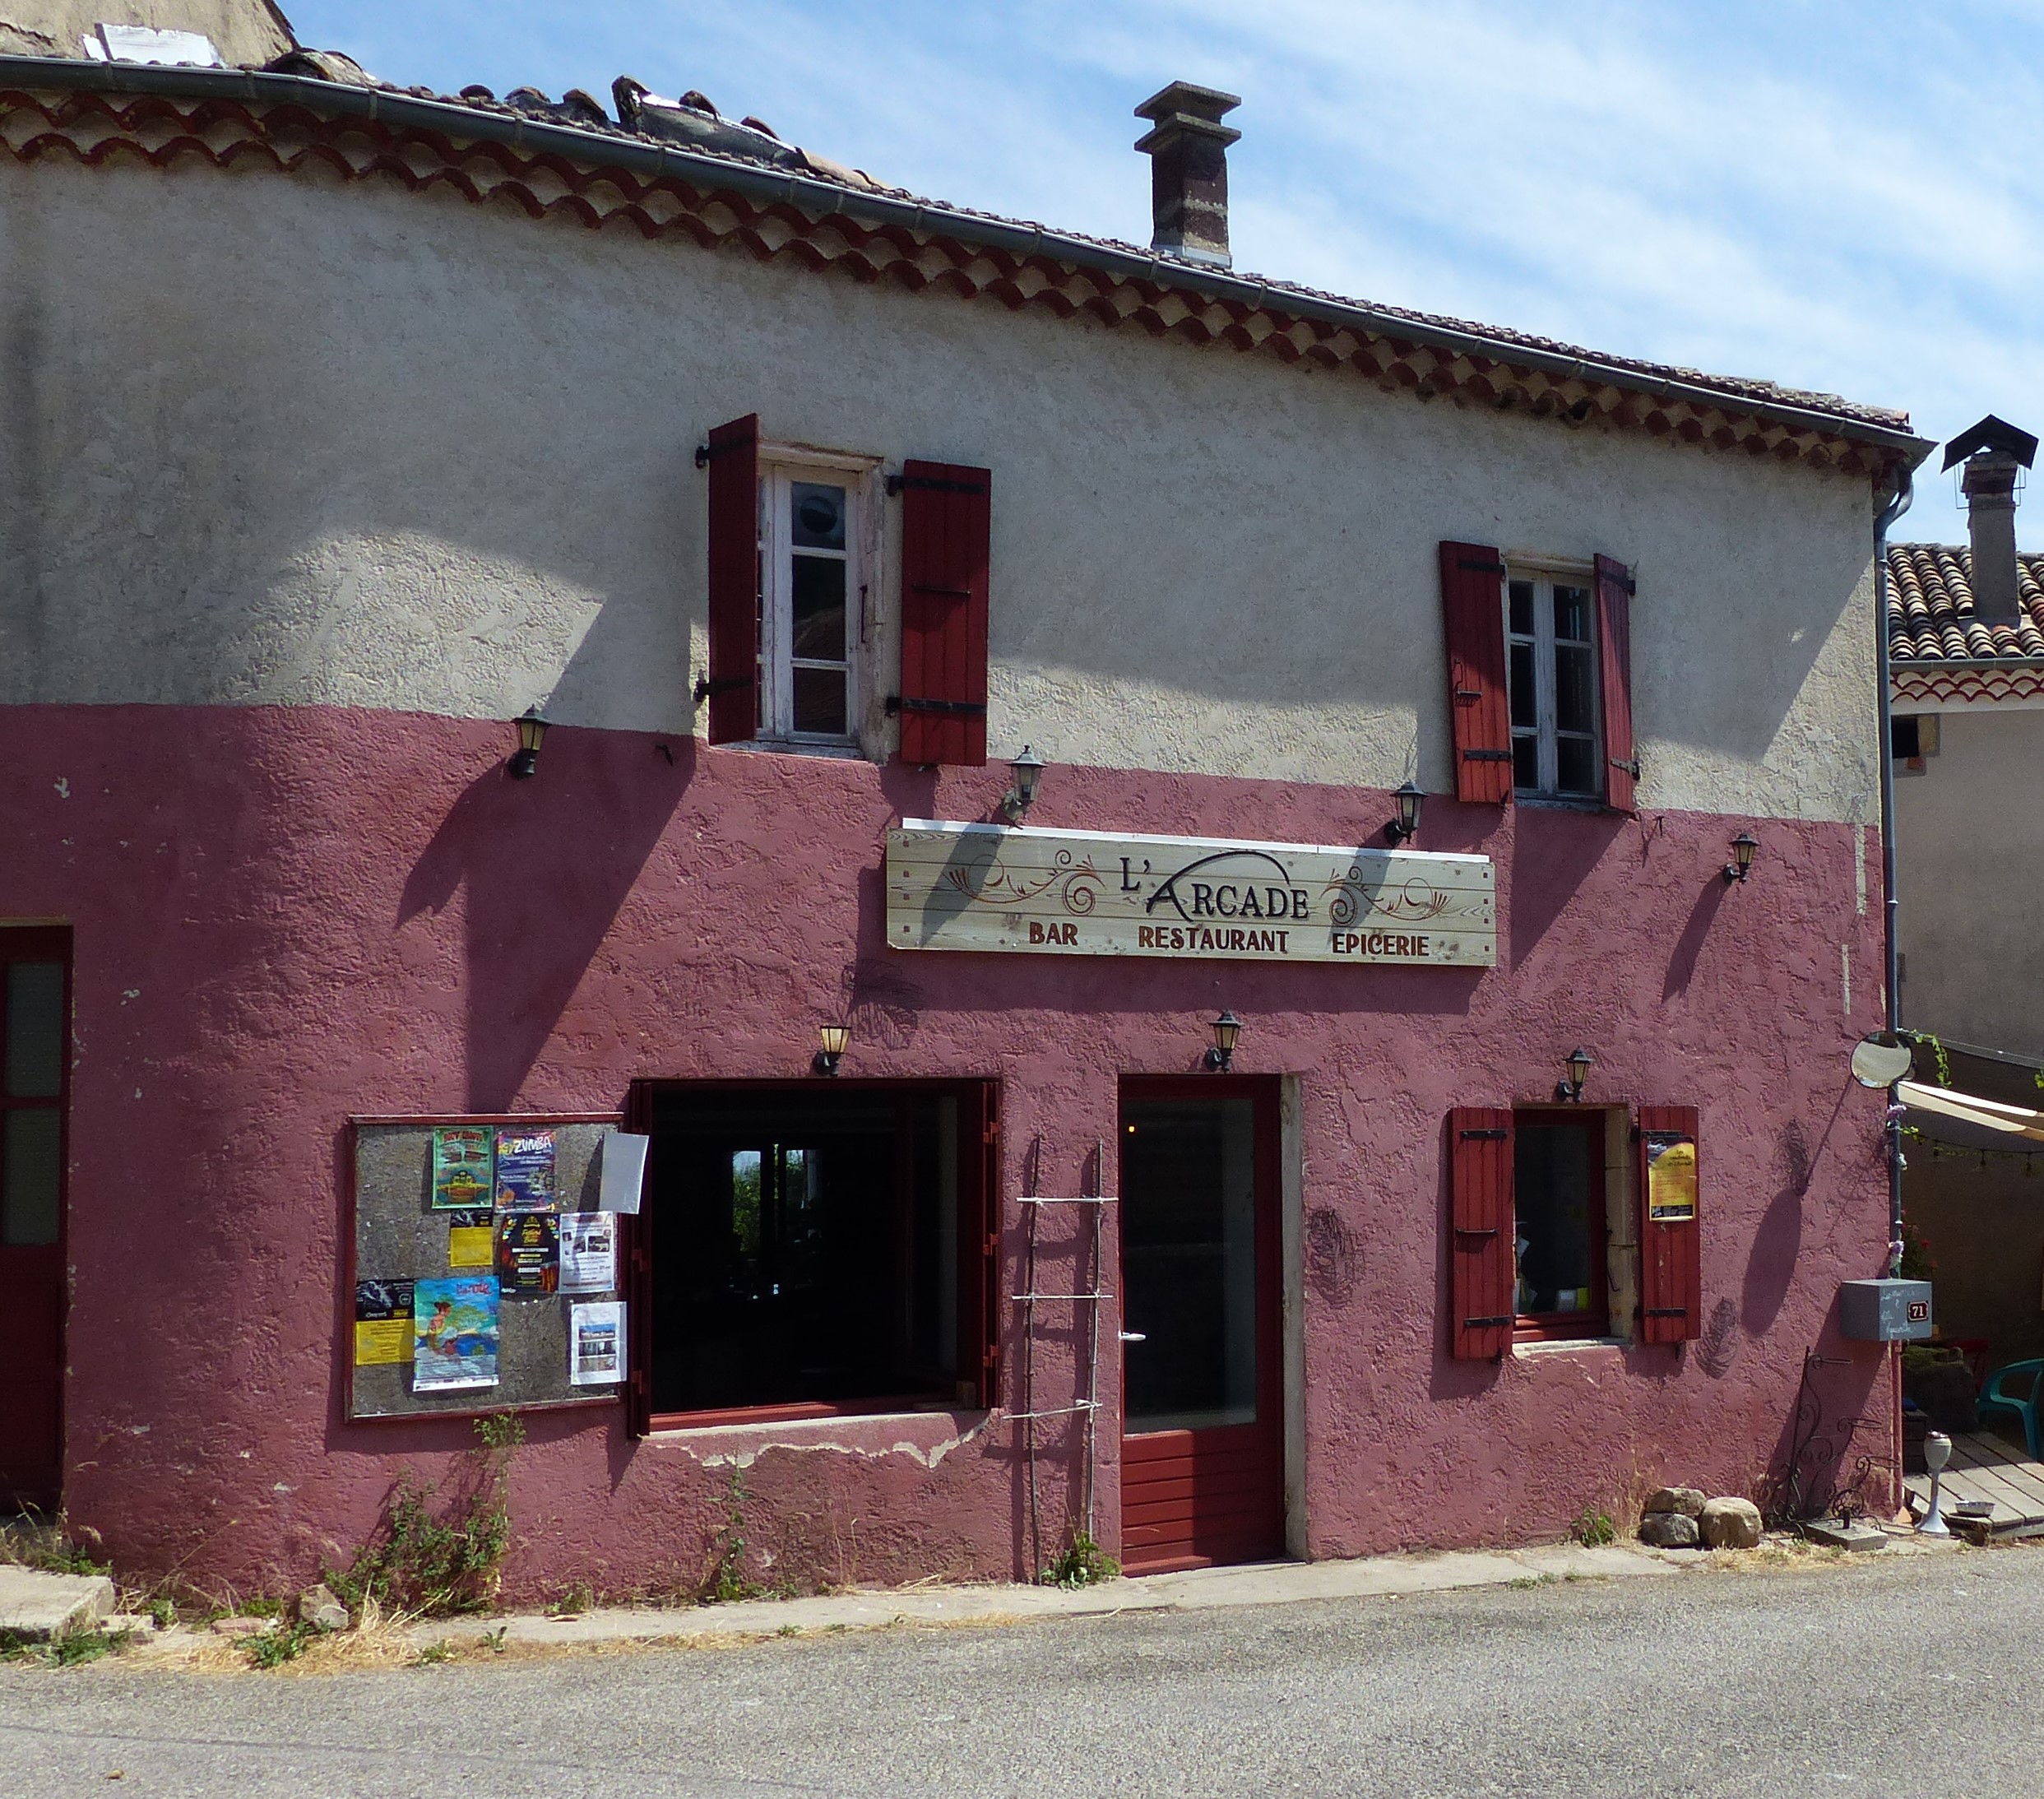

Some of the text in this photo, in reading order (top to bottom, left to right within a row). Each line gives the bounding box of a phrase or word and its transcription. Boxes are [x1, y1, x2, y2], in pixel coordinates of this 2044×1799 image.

[1119, 851, 1309, 922] L'ARCADE
[1029, 921, 1430, 956] BAR RESTAURANT EPICERIE
[514, 1135, 552, 1154] ZUMBA
[1912, 1305, 1925, 1317] 71
